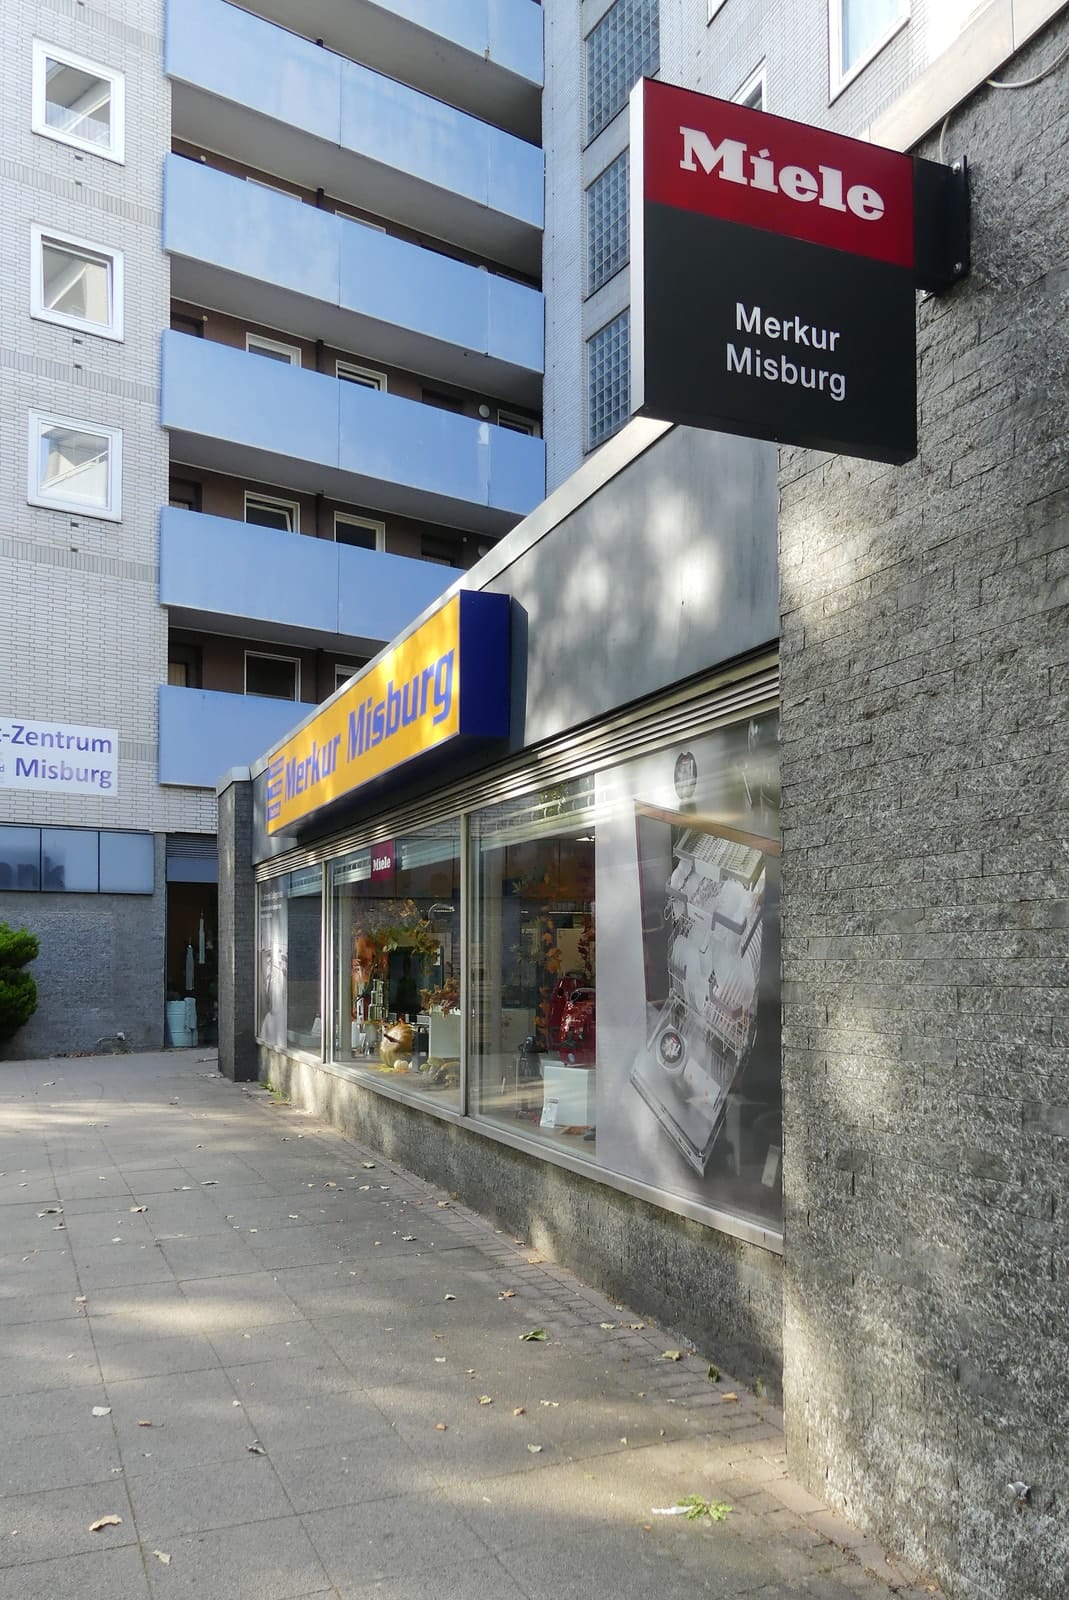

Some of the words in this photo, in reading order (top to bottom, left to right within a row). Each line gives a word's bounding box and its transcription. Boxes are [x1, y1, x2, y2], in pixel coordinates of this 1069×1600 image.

[679, 126, 885, 221] Miele
[735, 302, 841, 352] Merkur
[726, 343, 847, 401] Misburg
[0, 725, 112, 753] -Zentrum
[284, 733, 341, 801] Merkur
[347, 648, 455, 763] Misburg
[16, 757, 112, 789] Misburg
[372, 856, 391, 871] Miele
